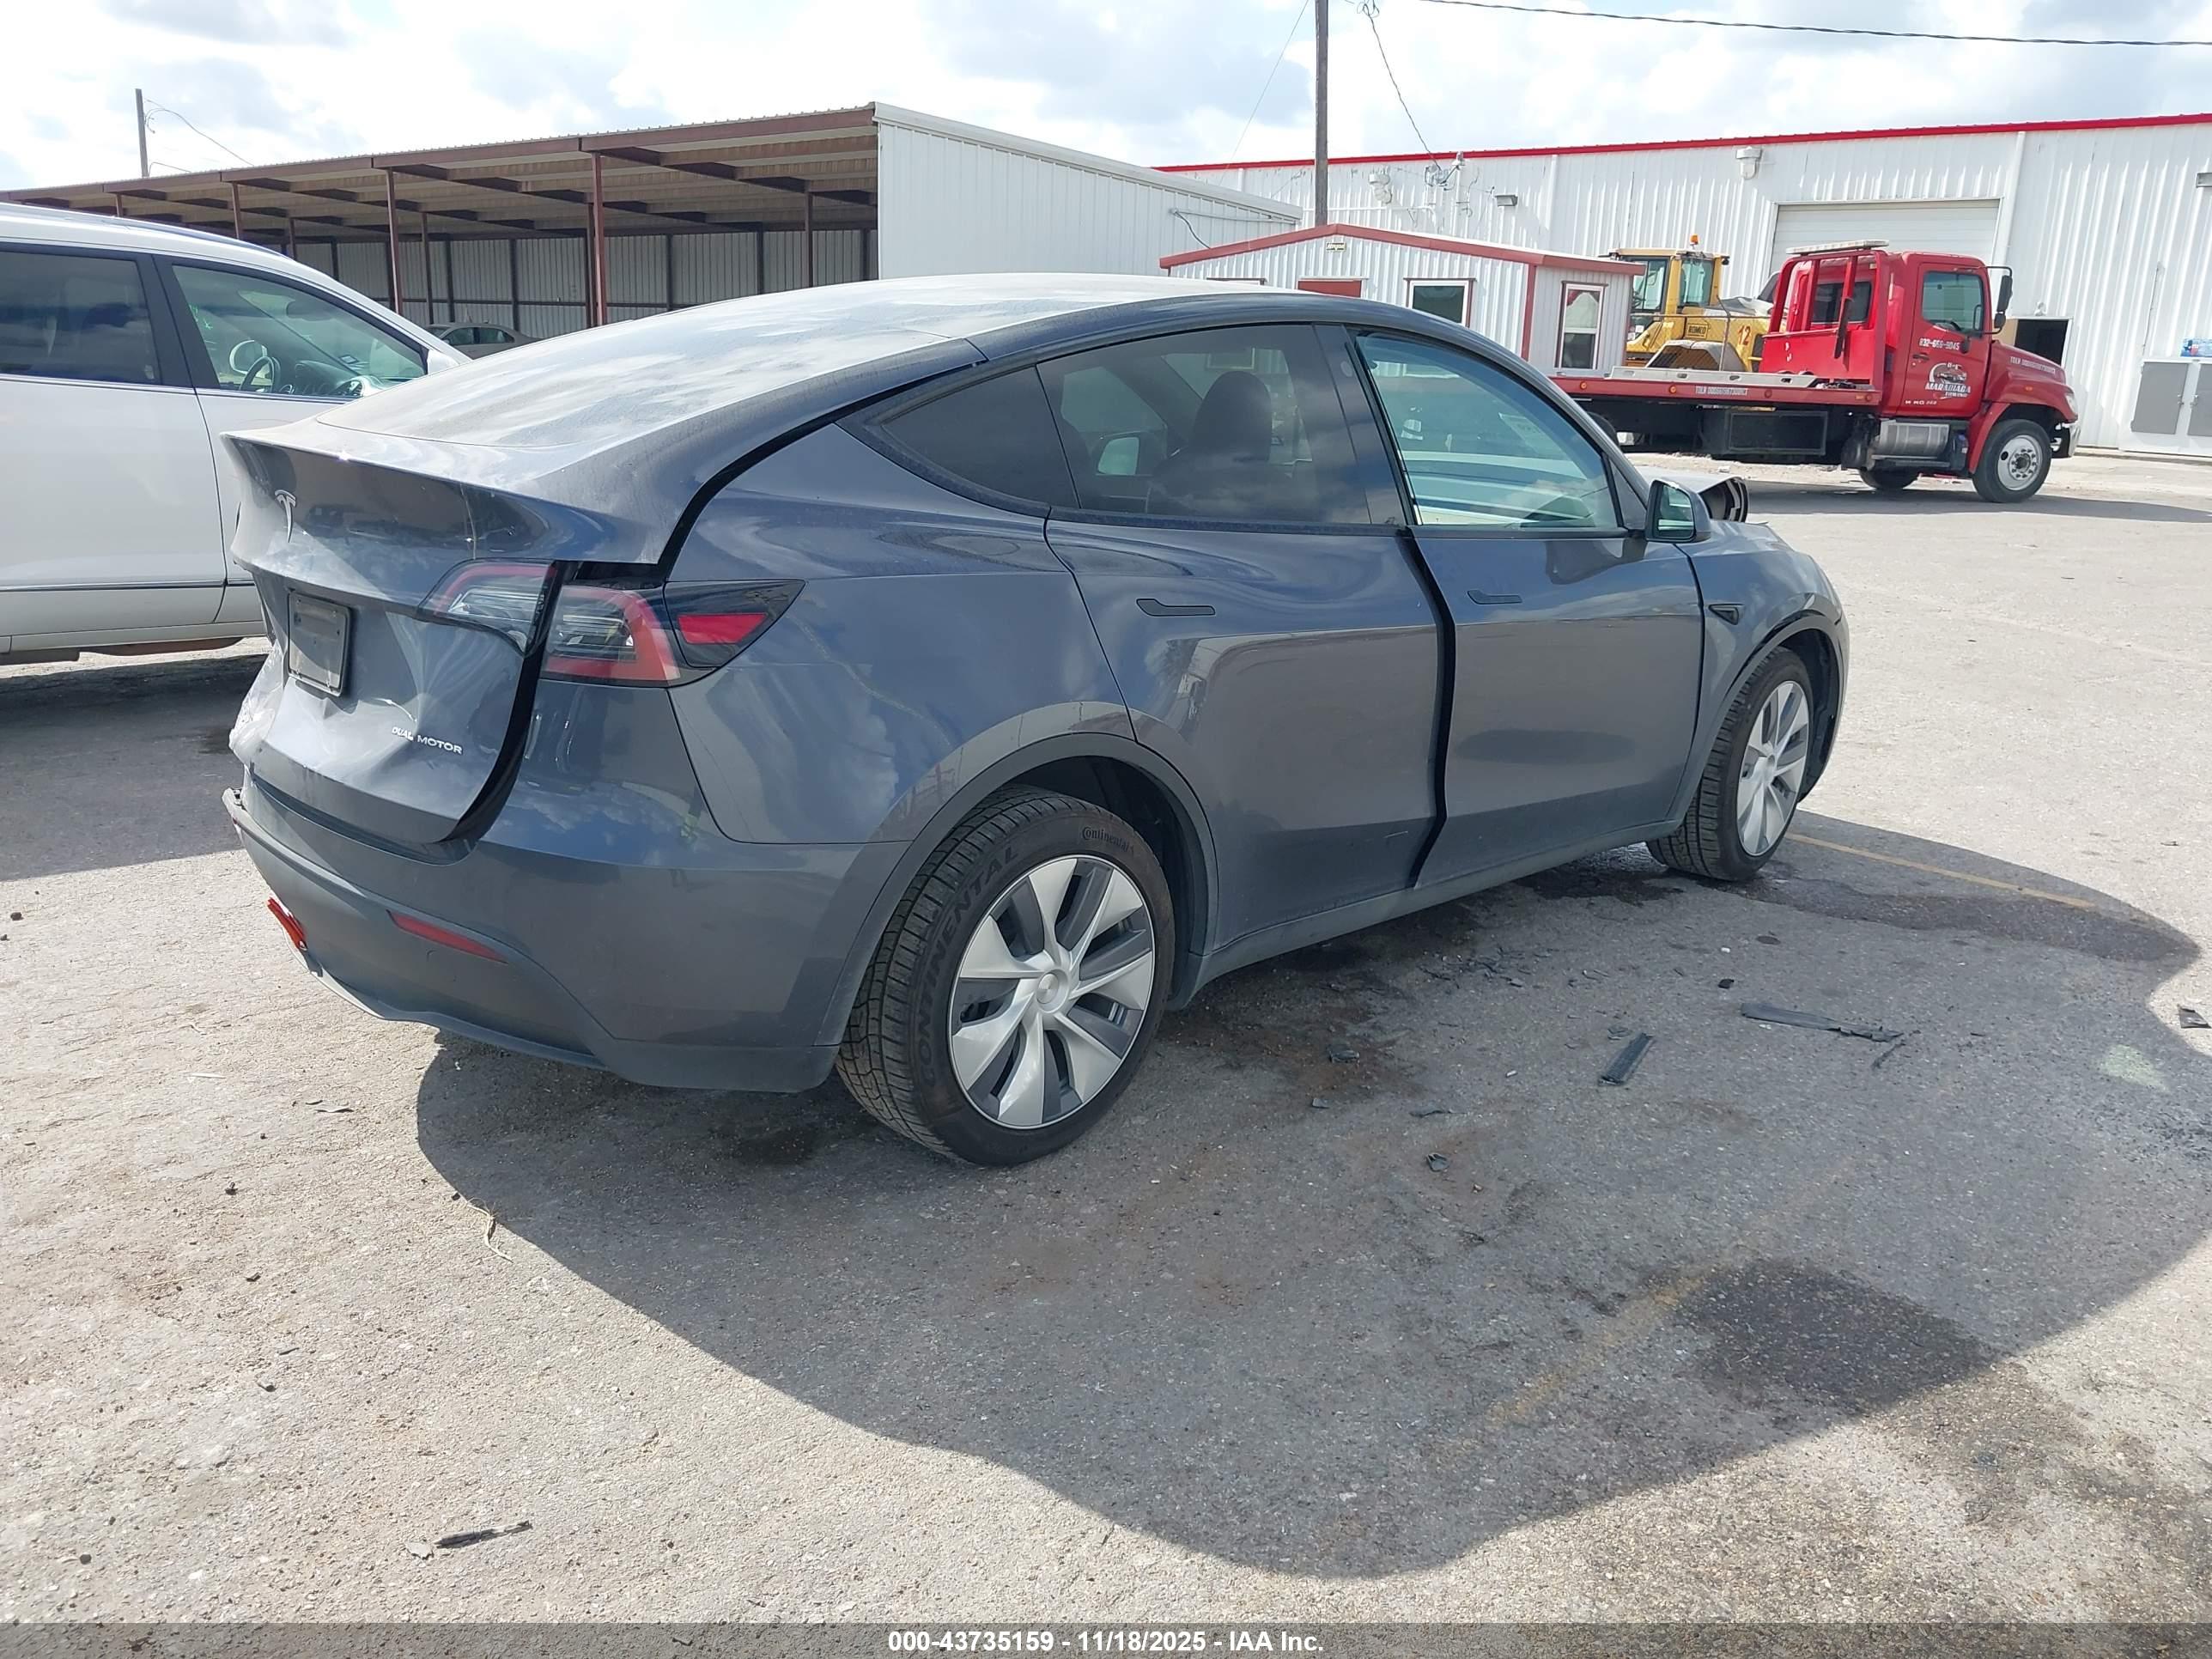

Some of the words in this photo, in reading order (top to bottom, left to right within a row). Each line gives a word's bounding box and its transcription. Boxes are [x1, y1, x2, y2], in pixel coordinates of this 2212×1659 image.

[1738, 325, 1751, 345] 12
[392, 726, 414, 740] DUAL
[417, 734, 463, 754] MOTOR
